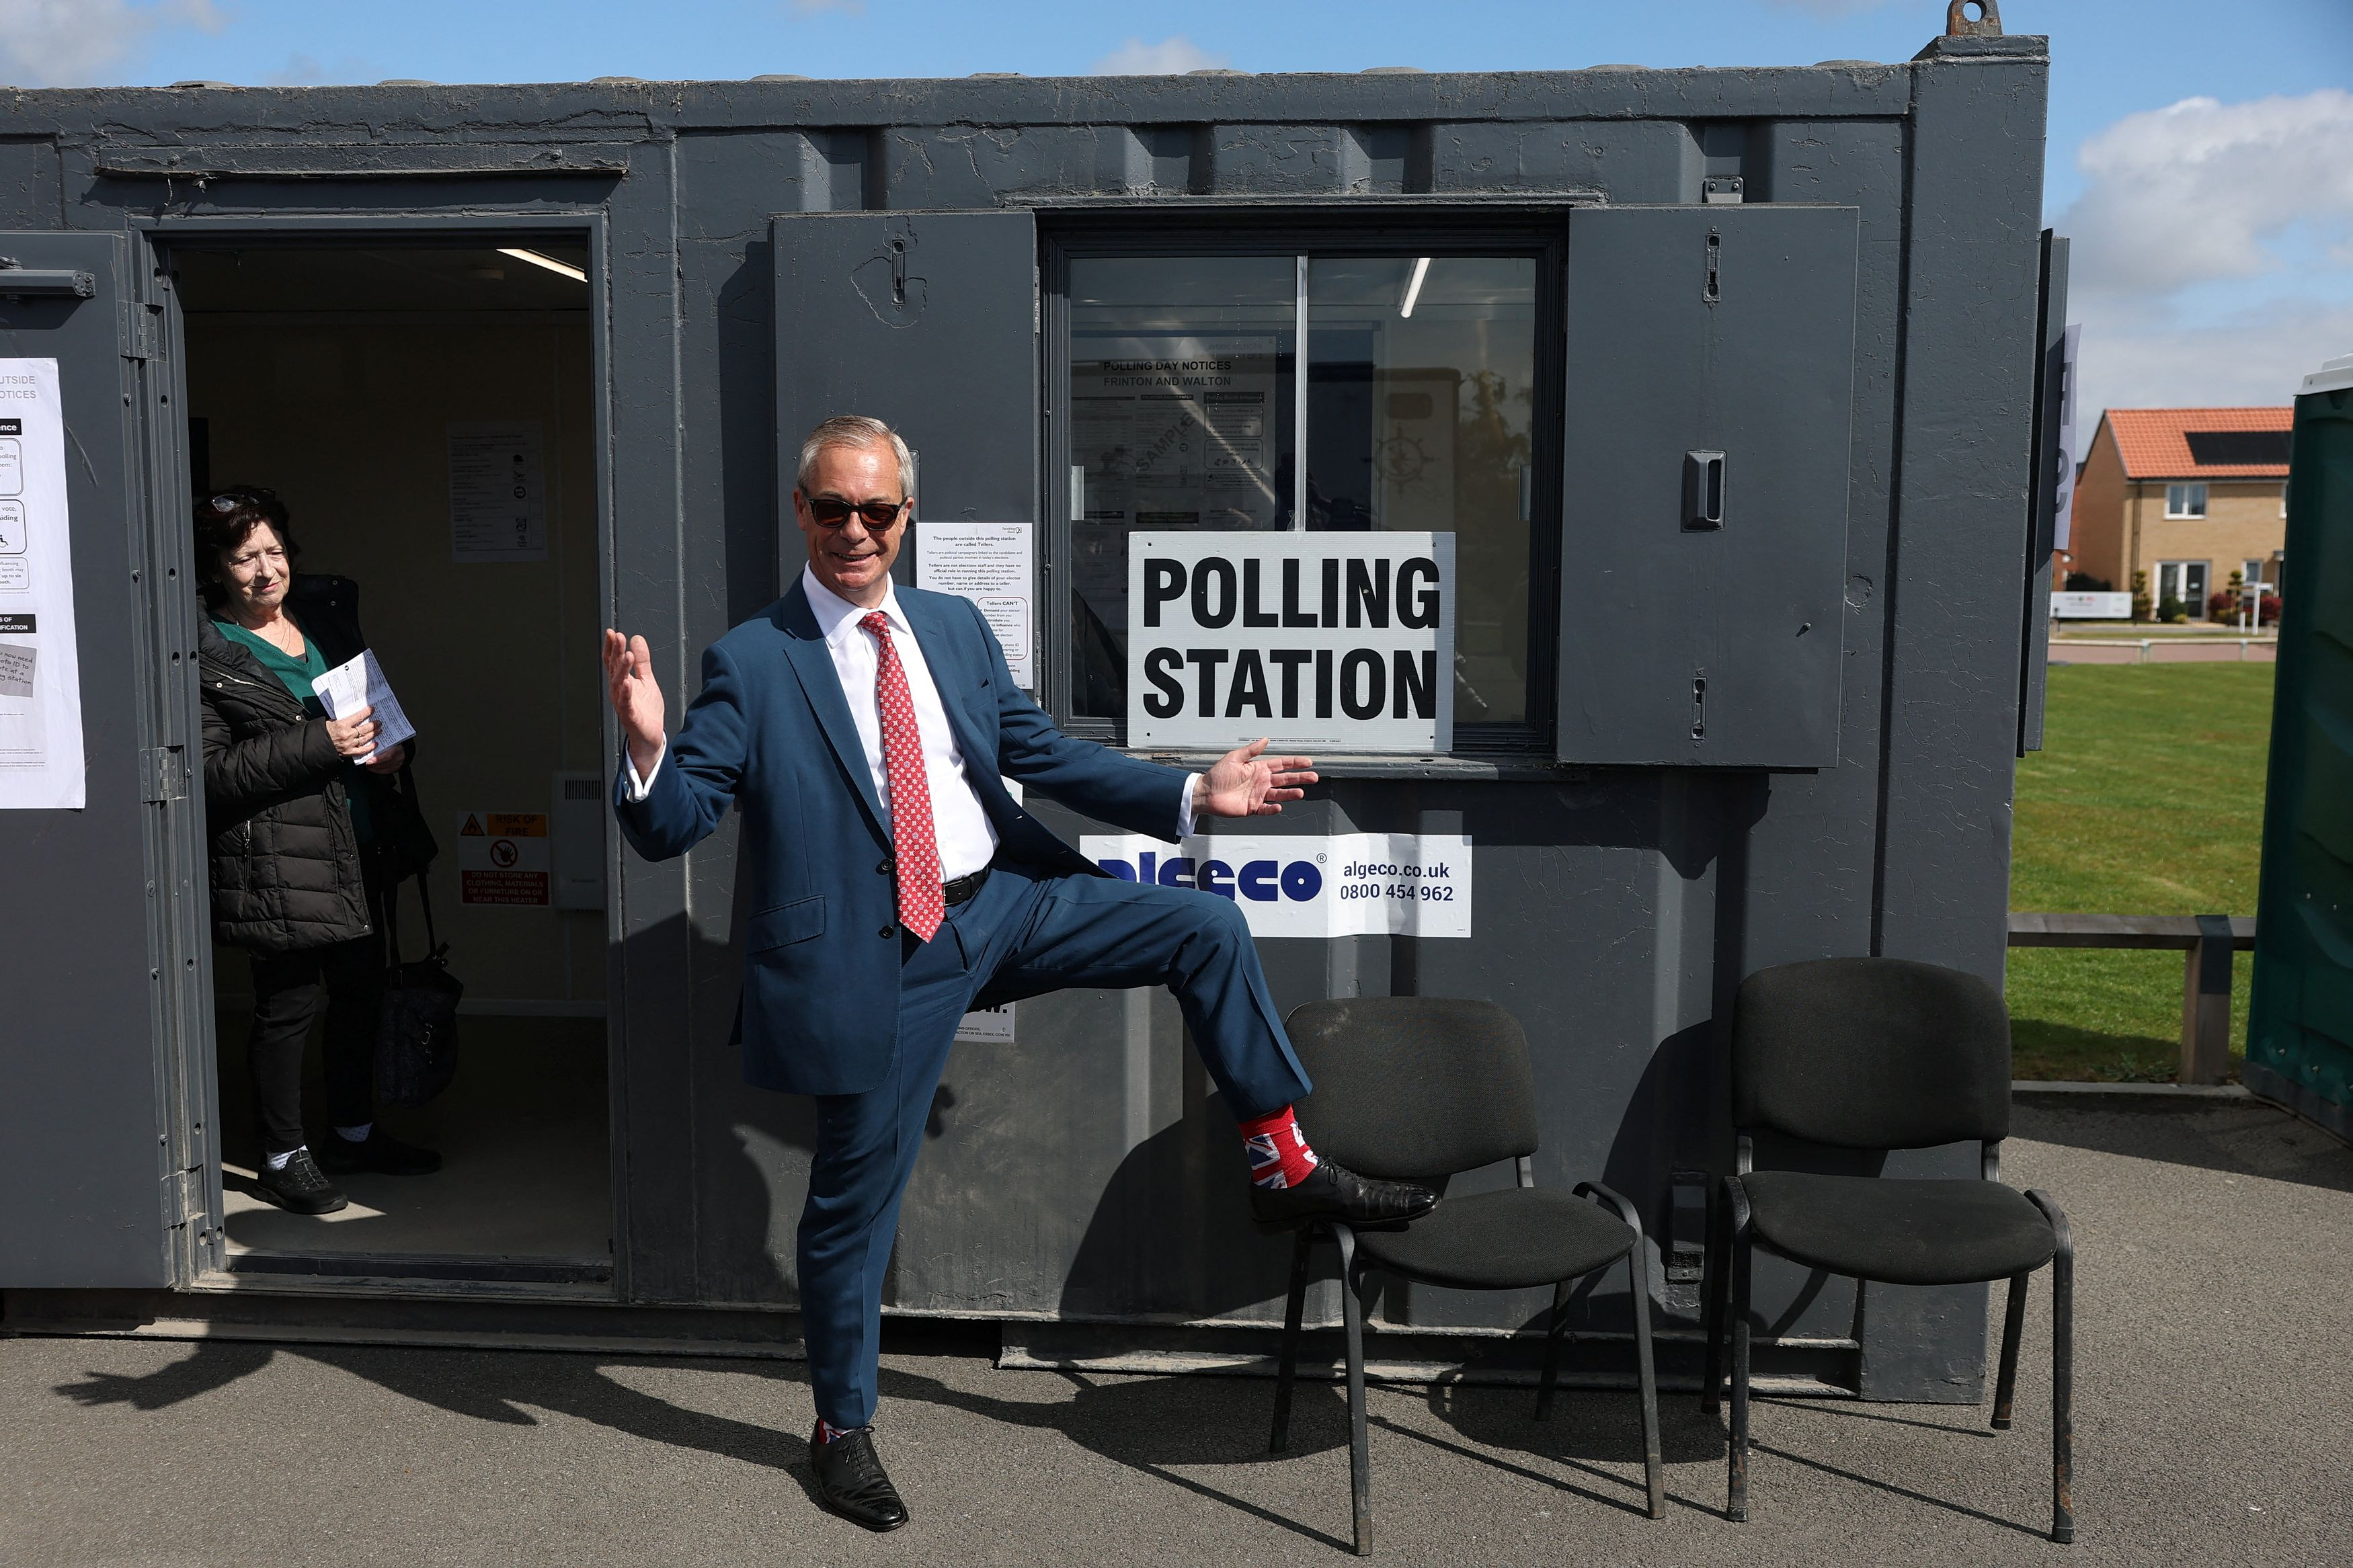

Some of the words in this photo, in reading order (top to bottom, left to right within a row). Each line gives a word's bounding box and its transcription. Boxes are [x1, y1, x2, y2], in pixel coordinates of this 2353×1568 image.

[1104, 361, 1152, 371] POLLING
[1156, 361, 1179, 371] DAY
[1182, 361, 1231, 371] NOTICES
[1104, 376, 1152, 386] FRINTON
[1156, 376, 1179, 386] AND
[1183, 376, 1231, 386] WALTON
[0, 390, 36, 399] OTICES
[1135, 412, 1195, 472] SAMPLE
[1144, 556, 1440, 629] POLLING
[7, 675, 31, 685] station
[1143, 647, 1437, 720] STATION
[495, 815, 520, 823] RISK
[523, 815, 538, 823] OF
[506, 828, 528, 836] FIRE
[1343, 860, 1450, 880] algeco.co.uk
[1341, 883, 1381, 901] 0800
[1386, 884, 1416, 901] 454
[1420, 885, 1453, 901] 962
